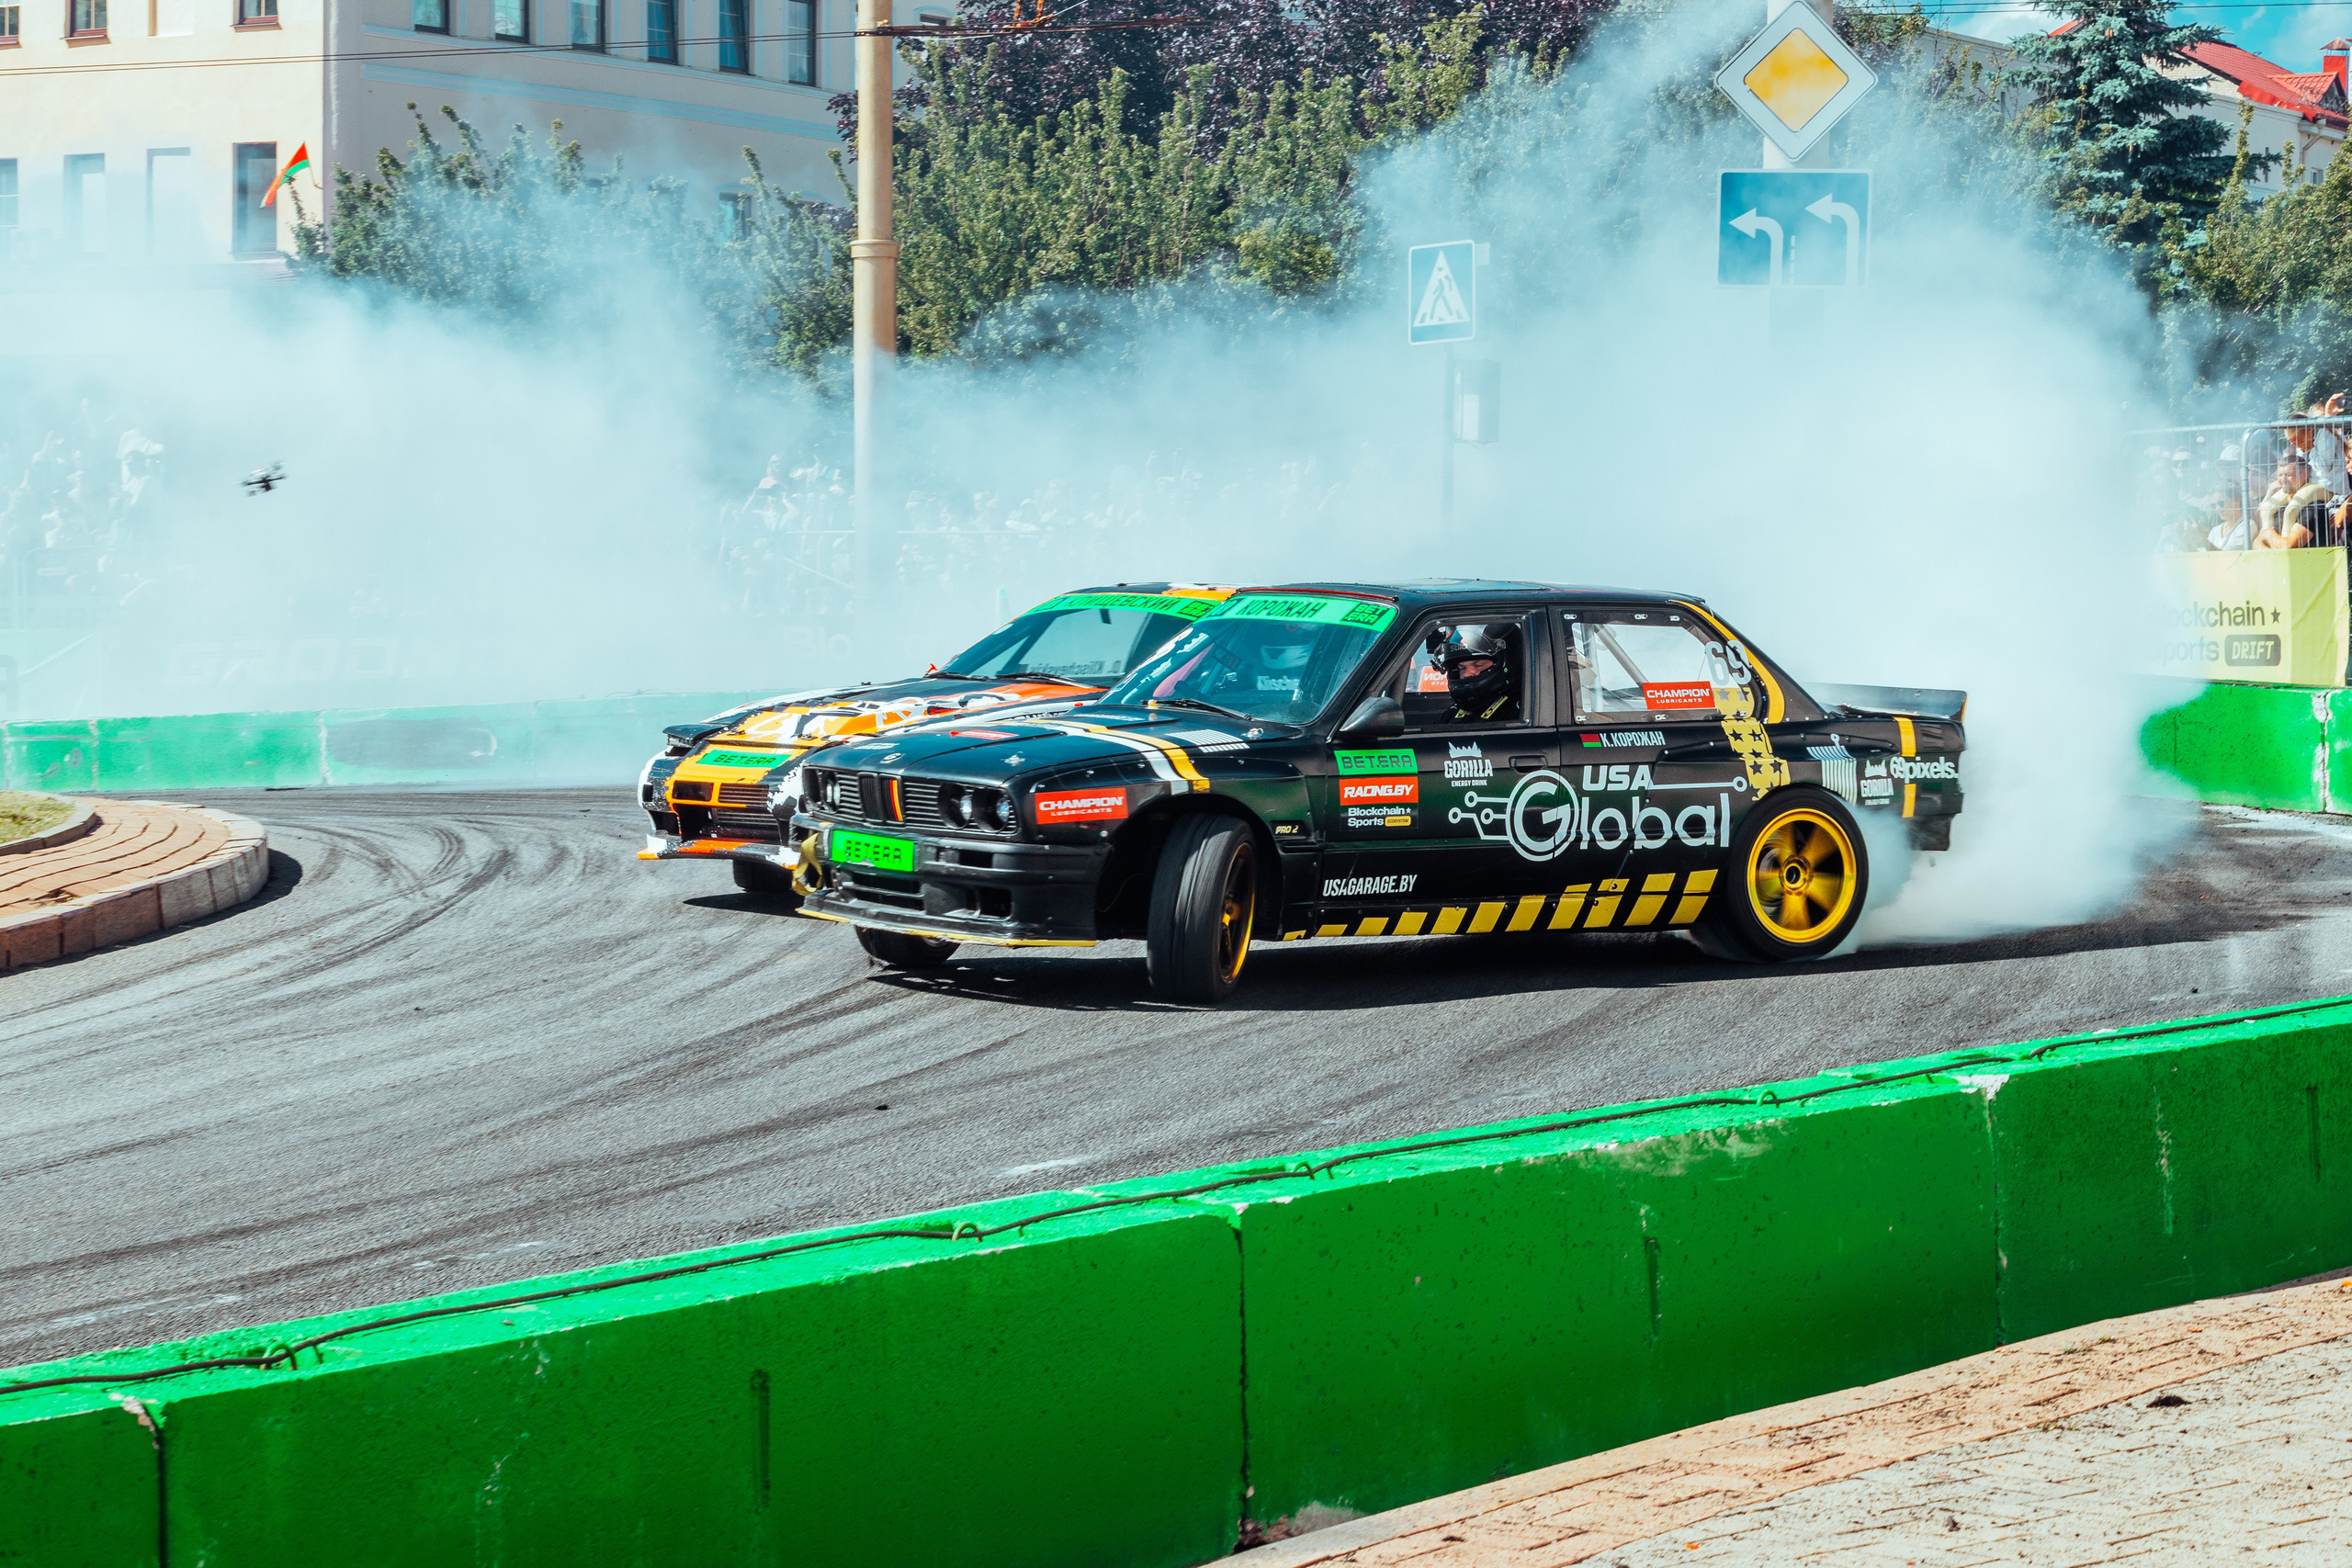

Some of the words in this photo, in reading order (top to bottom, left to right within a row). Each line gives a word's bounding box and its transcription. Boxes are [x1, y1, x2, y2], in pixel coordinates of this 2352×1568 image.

[1235, 600, 1329, 618] КОРОЖАН
[1354, 604, 1388, 615] BET
[2148, 600, 2266, 627] lockchain
[2231, 640, 2275, 660] DRIFT
[1704, 639, 1753, 686] 69
[1646, 688, 1710, 698] CHAMPION
[1443, 759, 1494, 779] GORILLA
[1451, 779, 1471, 787] ENERGY
[1582, 764, 1652, 791] USA
[1343, 784, 1414, 798] RACING.BY
[1039, 796, 1124, 811] CHAMPION
[1050, 807, 1113, 817] LUBRICANTS
[1348, 807, 1405, 817] Blockchain
[1513, 781, 1731, 853] Global
[1275, 826, 1291, 834] PRO
[1348, 818, 1384, 828] Sports
[1323, 874, 1418, 897] USAGARAGE.BY
